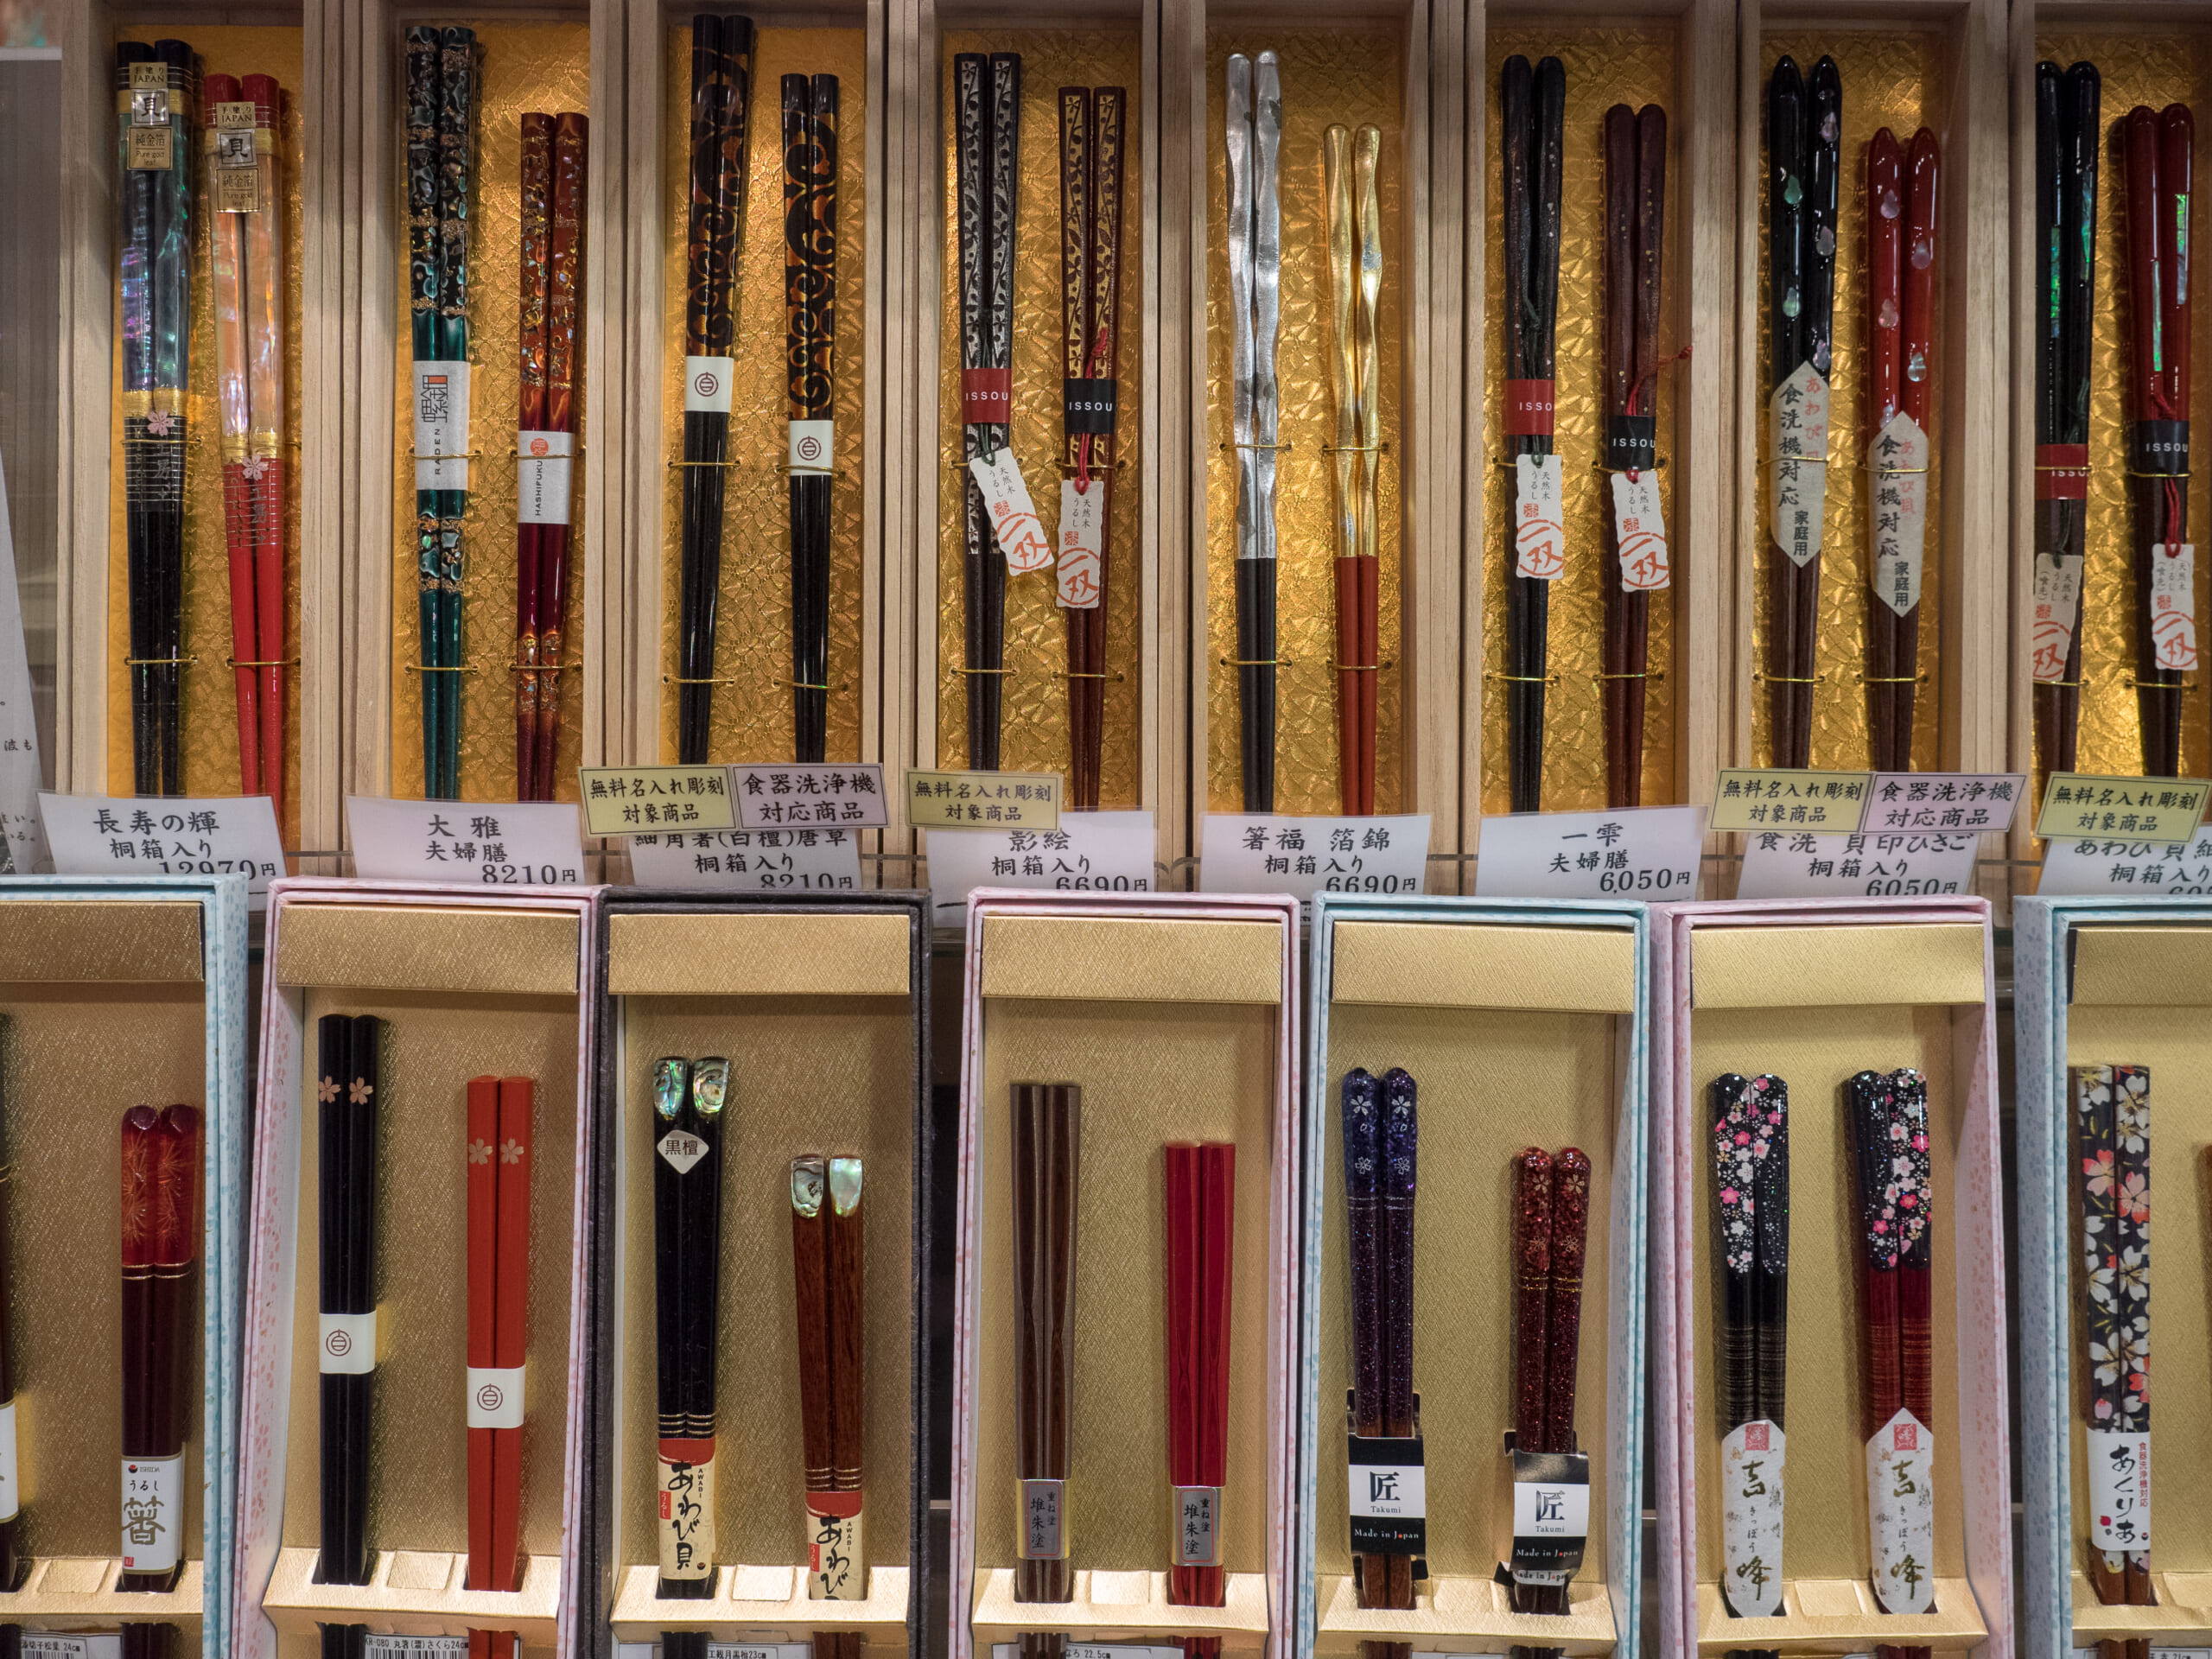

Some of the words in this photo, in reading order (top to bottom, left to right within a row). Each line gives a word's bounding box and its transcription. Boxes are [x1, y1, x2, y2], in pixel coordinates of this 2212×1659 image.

[133, 74, 165, 83] JAPAN
[142, 97, 161, 117] 貝
[221, 114, 253, 123] JAPAN
[227, 137, 249, 158] 貝
[965, 391, 1009, 401] ISSOU
[1069, 401, 1113, 411] ISSOU
[1613, 438, 1656, 448] ISSOU
[1778, 384, 1803, 507] 食洗機対応
[2146, 442, 2189, 453] ISSOU
[534, 461, 544, 517] HASHIFUKU
[1876, 435, 1901, 558] 食洗機対応
[1793, 511, 1808, 556] 家庭用
[1893, 561, 1910, 607] 家庭用
[590, 776, 725, 798] 無料名入れ彫刻
[742, 772, 877, 796] 食器洗浄機
[914, 780, 1052, 803] 無料名入れ彫刻
[1722, 779, 1864, 802] 無料名入れ彫刻
[1878, 780, 2012, 803] 食器洗浄機
[2053, 785, 2200, 811] 無料名入れ彫刻
[92, 809, 220, 836] 長寿の輝
[623, 803, 700, 824] 対象商品
[760, 800, 865, 823] 対応商品
[945, 804, 1023, 822] 対象商品
[1749, 804, 1827, 823] 対象商品
[1885, 807, 1990, 828] 対応商品
[2076, 812, 2158, 832] 対象商品
[1008, 830, 1072, 852] 影絵
[1561, 822, 1624, 847] 一雫
[110, 837, 213, 859] 桐箱入り
[424, 840, 509, 863] 夫婦膳
[694, 852, 793, 874] 桐箱入り
[991, 854, 1091, 877] 桐箱入り
[1264, 854, 1364, 875] 桐箱入り
[1548, 849, 1630, 874] 夫婦膳
[1808, 858, 1909, 879] 桐箱入り
[481, 864, 576, 885] 8210円
[1325, 874, 1417, 894] 6690円
[2108, 862, 2210, 885] 桐箱入り
[664, 1139, 698, 1155] 黒檀
[130, 1479, 159, 1491] うるし
[1370, 1471, 1401, 1502] 匠
[2109, 1444, 2136, 1544] あくりあ
[667, 1459, 702, 1570] あわび貝
[1370, 1505, 1402, 1514] Takumi
[1535, 1489, 1566, 1522] 匠
[1354, 1528, 1378, 1538] Made
[1381, 1529, 1391, 1539] in
[1535, 1525, 1566, 1534] Takumi
[816, 1513, 850, 1600] あわび
[1516, 1548, 1540, 1557] Made
